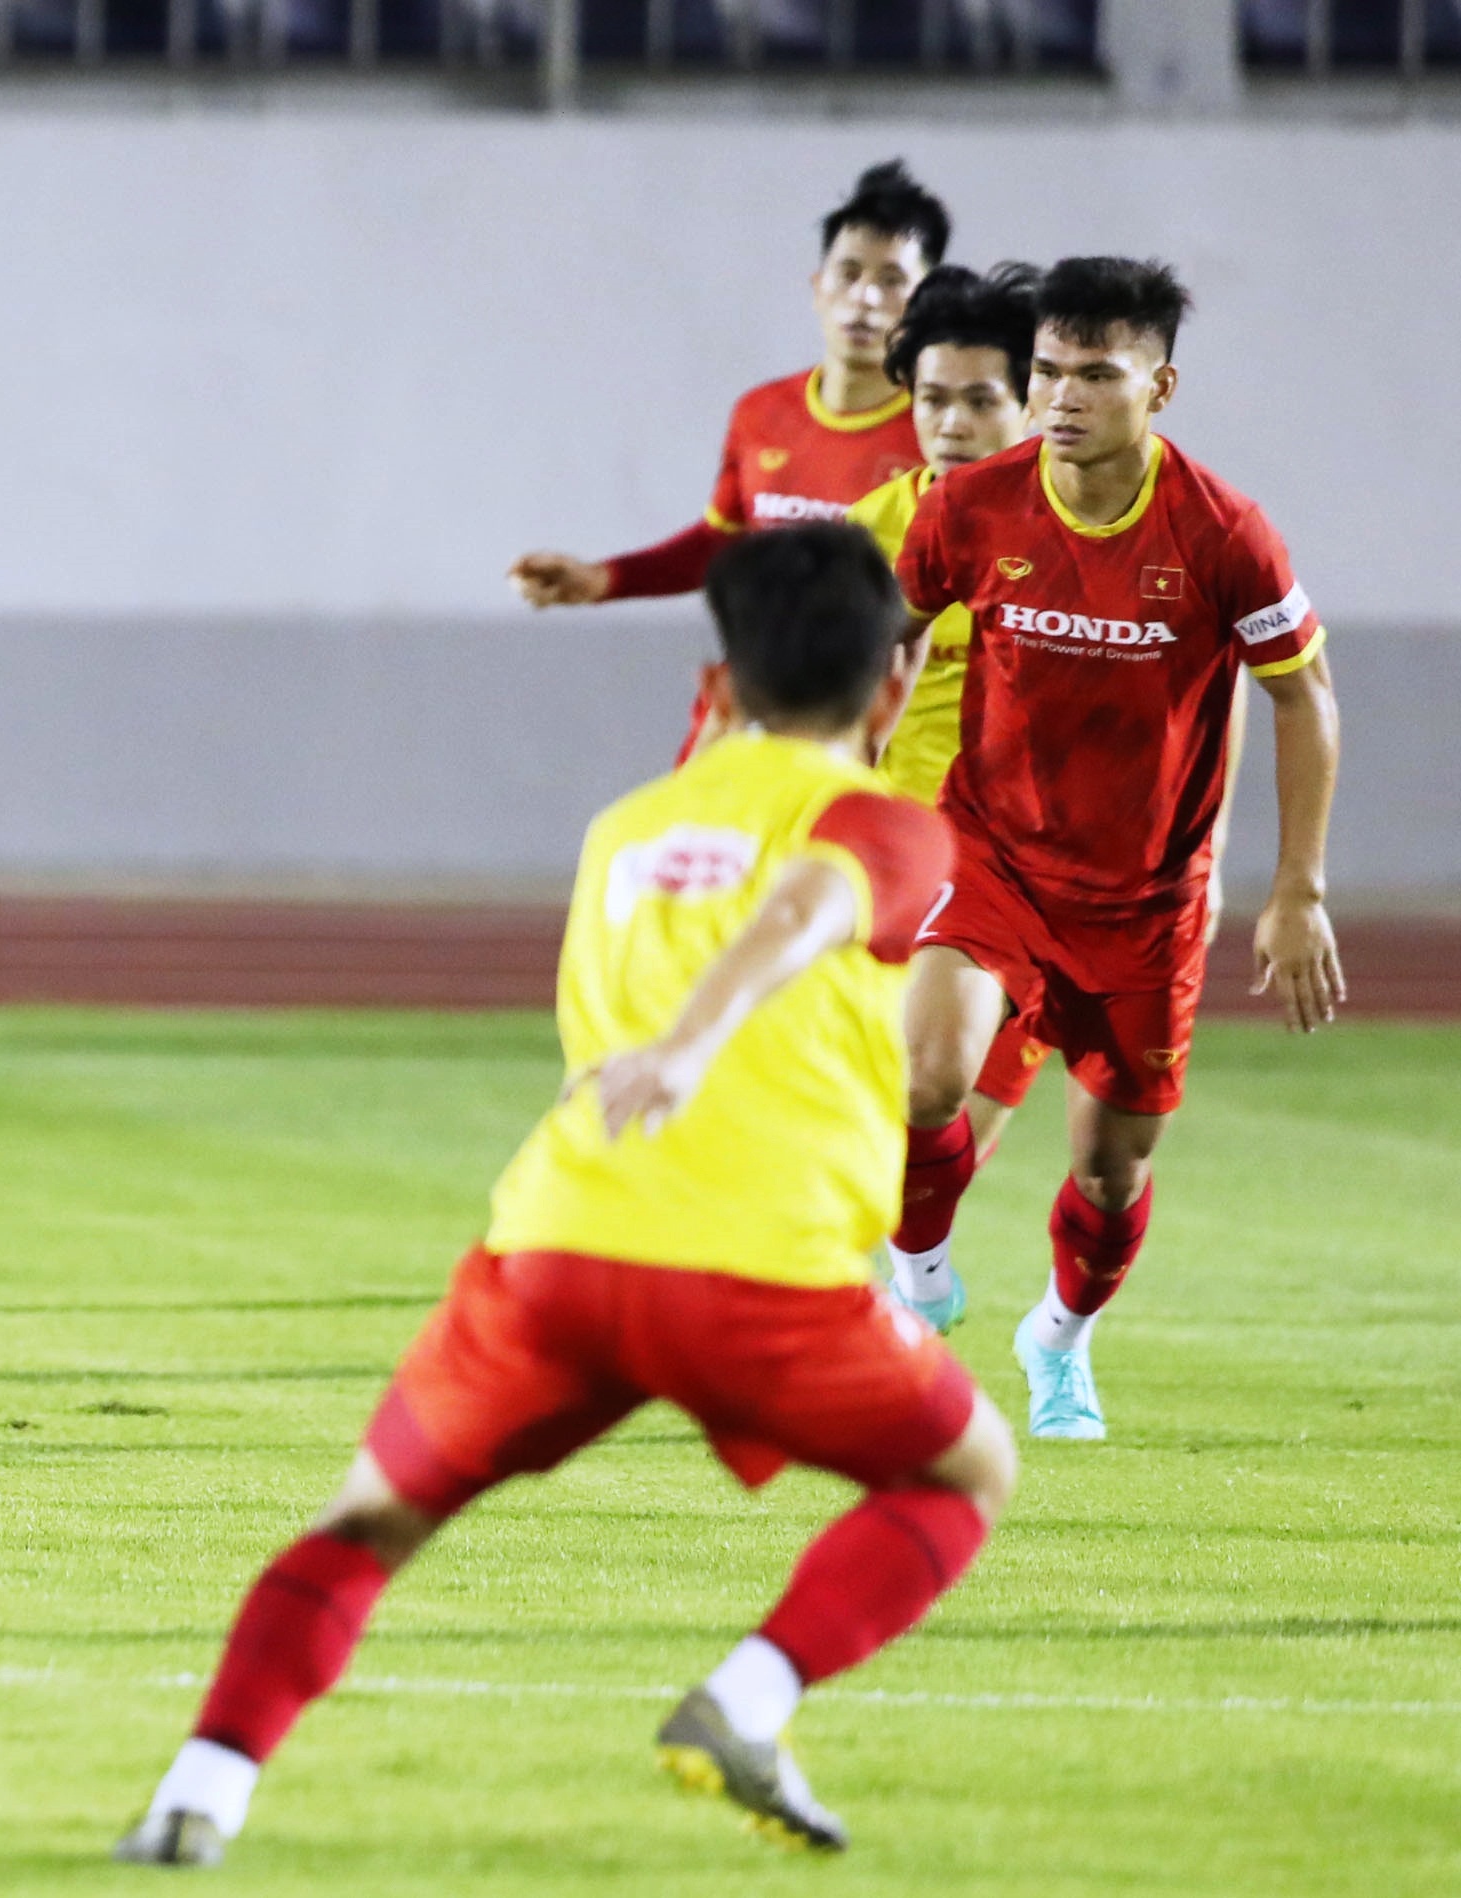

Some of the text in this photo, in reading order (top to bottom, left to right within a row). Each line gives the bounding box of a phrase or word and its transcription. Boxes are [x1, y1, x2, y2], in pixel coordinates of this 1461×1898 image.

[1000, 603, 1178, 645] HONDA
[1012, 634, 1162, 662] The Power of Dreams
